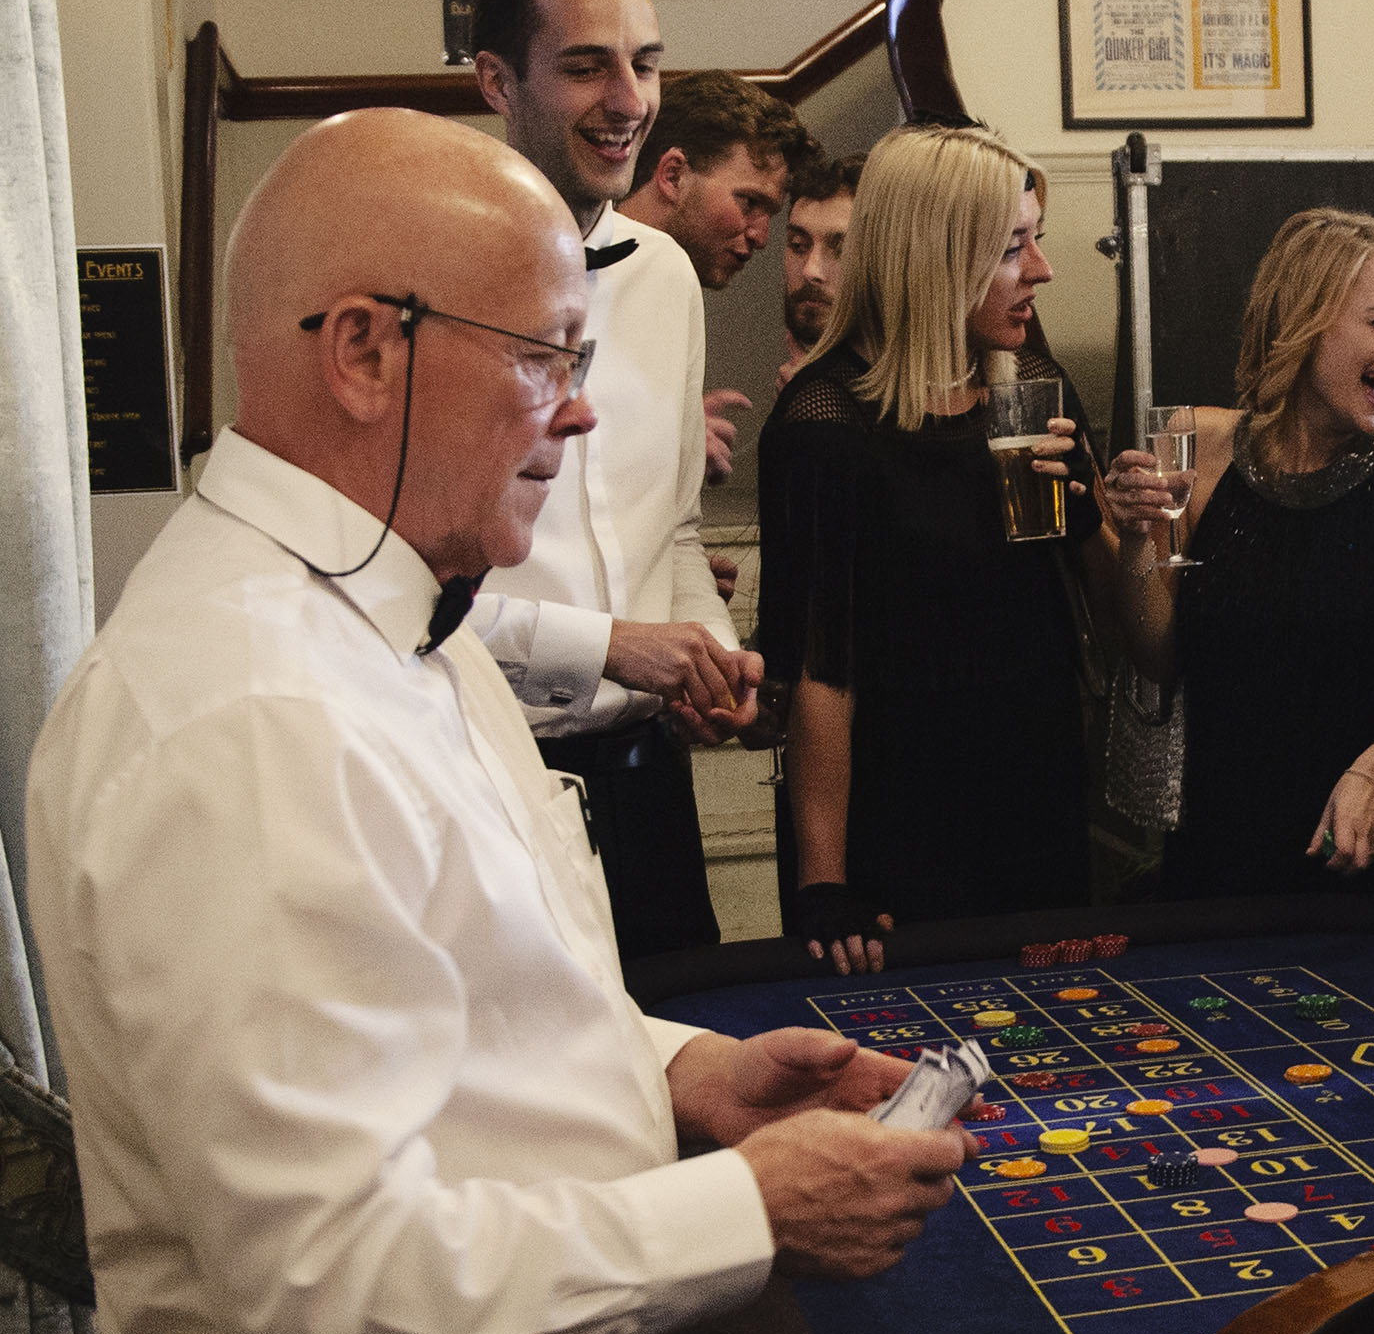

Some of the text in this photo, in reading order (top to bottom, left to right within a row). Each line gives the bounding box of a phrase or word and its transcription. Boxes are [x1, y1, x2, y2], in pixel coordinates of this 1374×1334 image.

[1105, 36, 1172, 61] QUAKER GIRL
[1203, 52, 1270, 69] IT'S MAGIC
[85, 260, 144, 278] EVENTS
[1009, 1051, 1070, 1067] 26
[1138, 1062, 1203, 1079] 22
[1165, 1083, 1223, 1100] 19
[1054, 1094, 1119, 1112] 20
[1190, 1105, 1251, 1123] 16
[1217, 1127, 1285, 1147] 13
[1250, 1155, 1319, 1176] 10
[1001, 1184, 1073, 1208] 12
[1303, 1184, 1335, 1202] 7
[1170, 1198, 1212, 1218] 8
[1044, 1215, 1083, 1234] 9
[1324, 1211, 1366, 1232] 4
[1199, 1227, 1238, 1248] 5
[1067, 1245, 1108, 1266] 6
[1228, 1258, 1274, 1281] 2
[1102, 1275, 1142, 1298] 3
